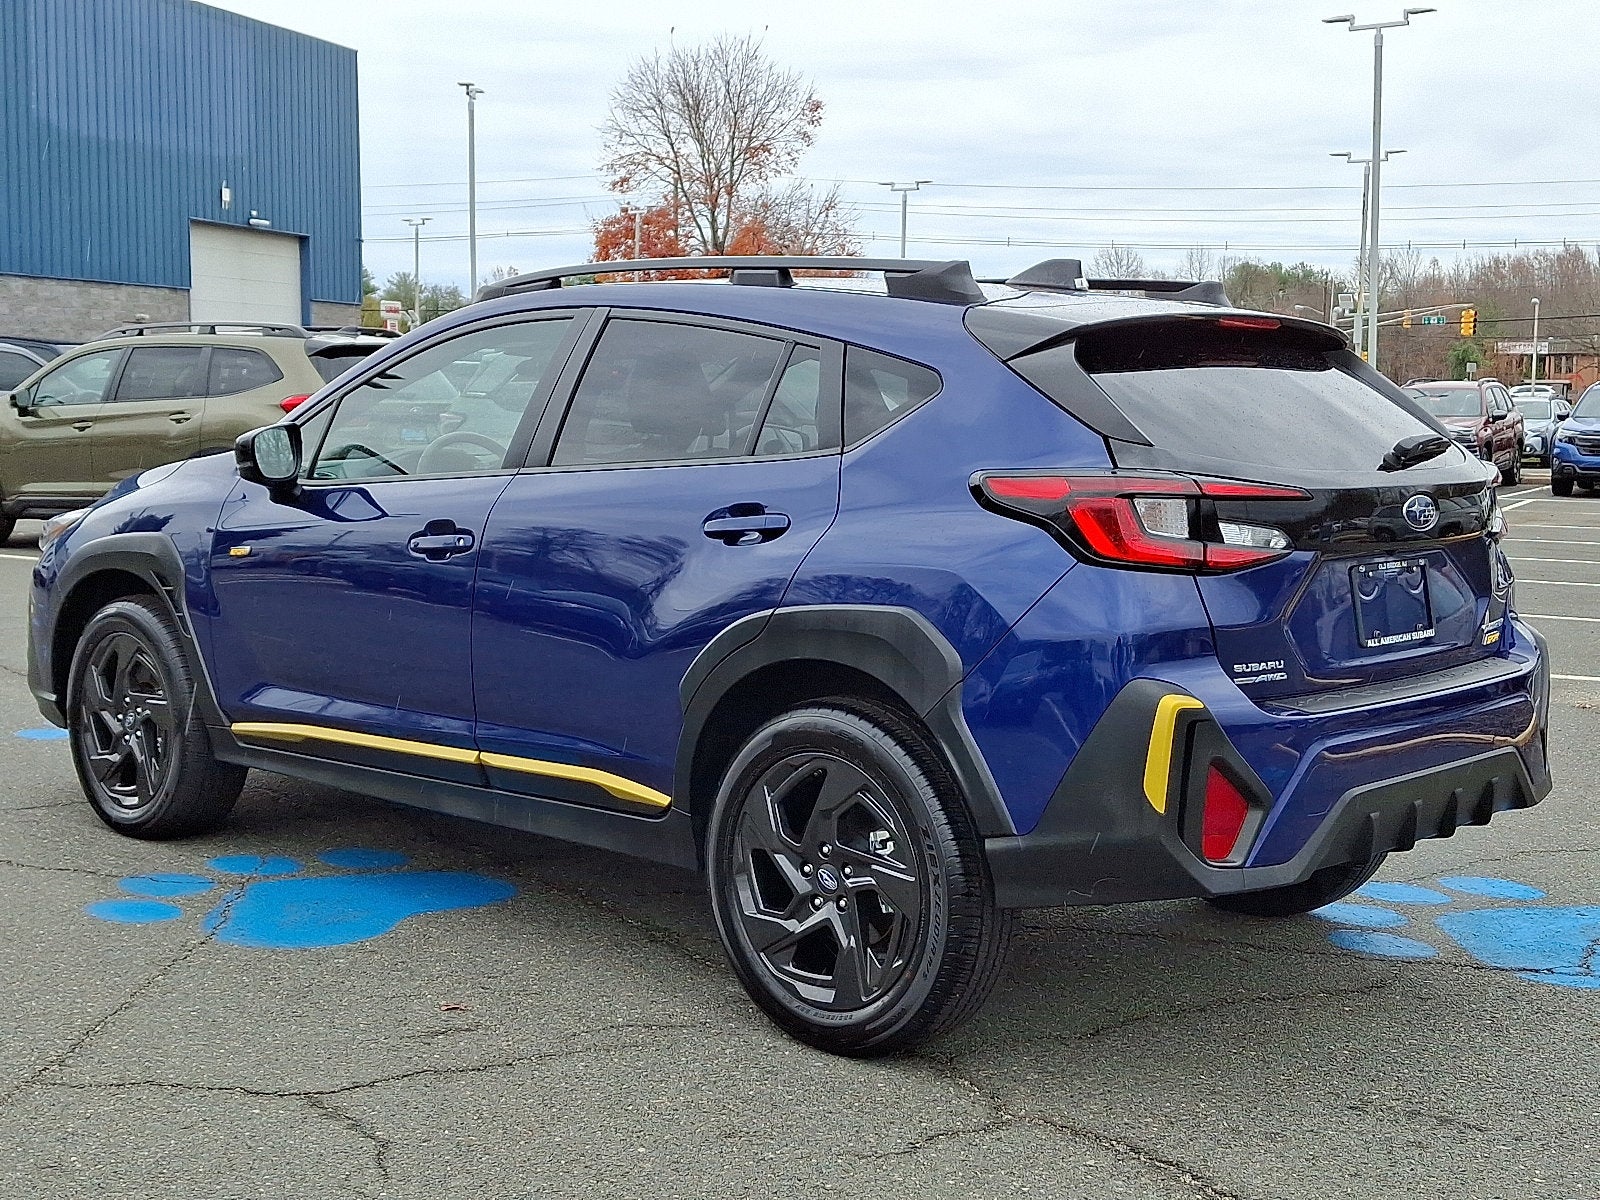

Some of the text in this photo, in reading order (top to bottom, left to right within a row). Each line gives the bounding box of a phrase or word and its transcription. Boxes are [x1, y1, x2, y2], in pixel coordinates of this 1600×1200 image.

[1367, 628, 1435, 647] ALL AMERICAN SUBARU
[1233, 660, 1284, 672] SUBARU
[1255, 672, 1288, 683] AWD
